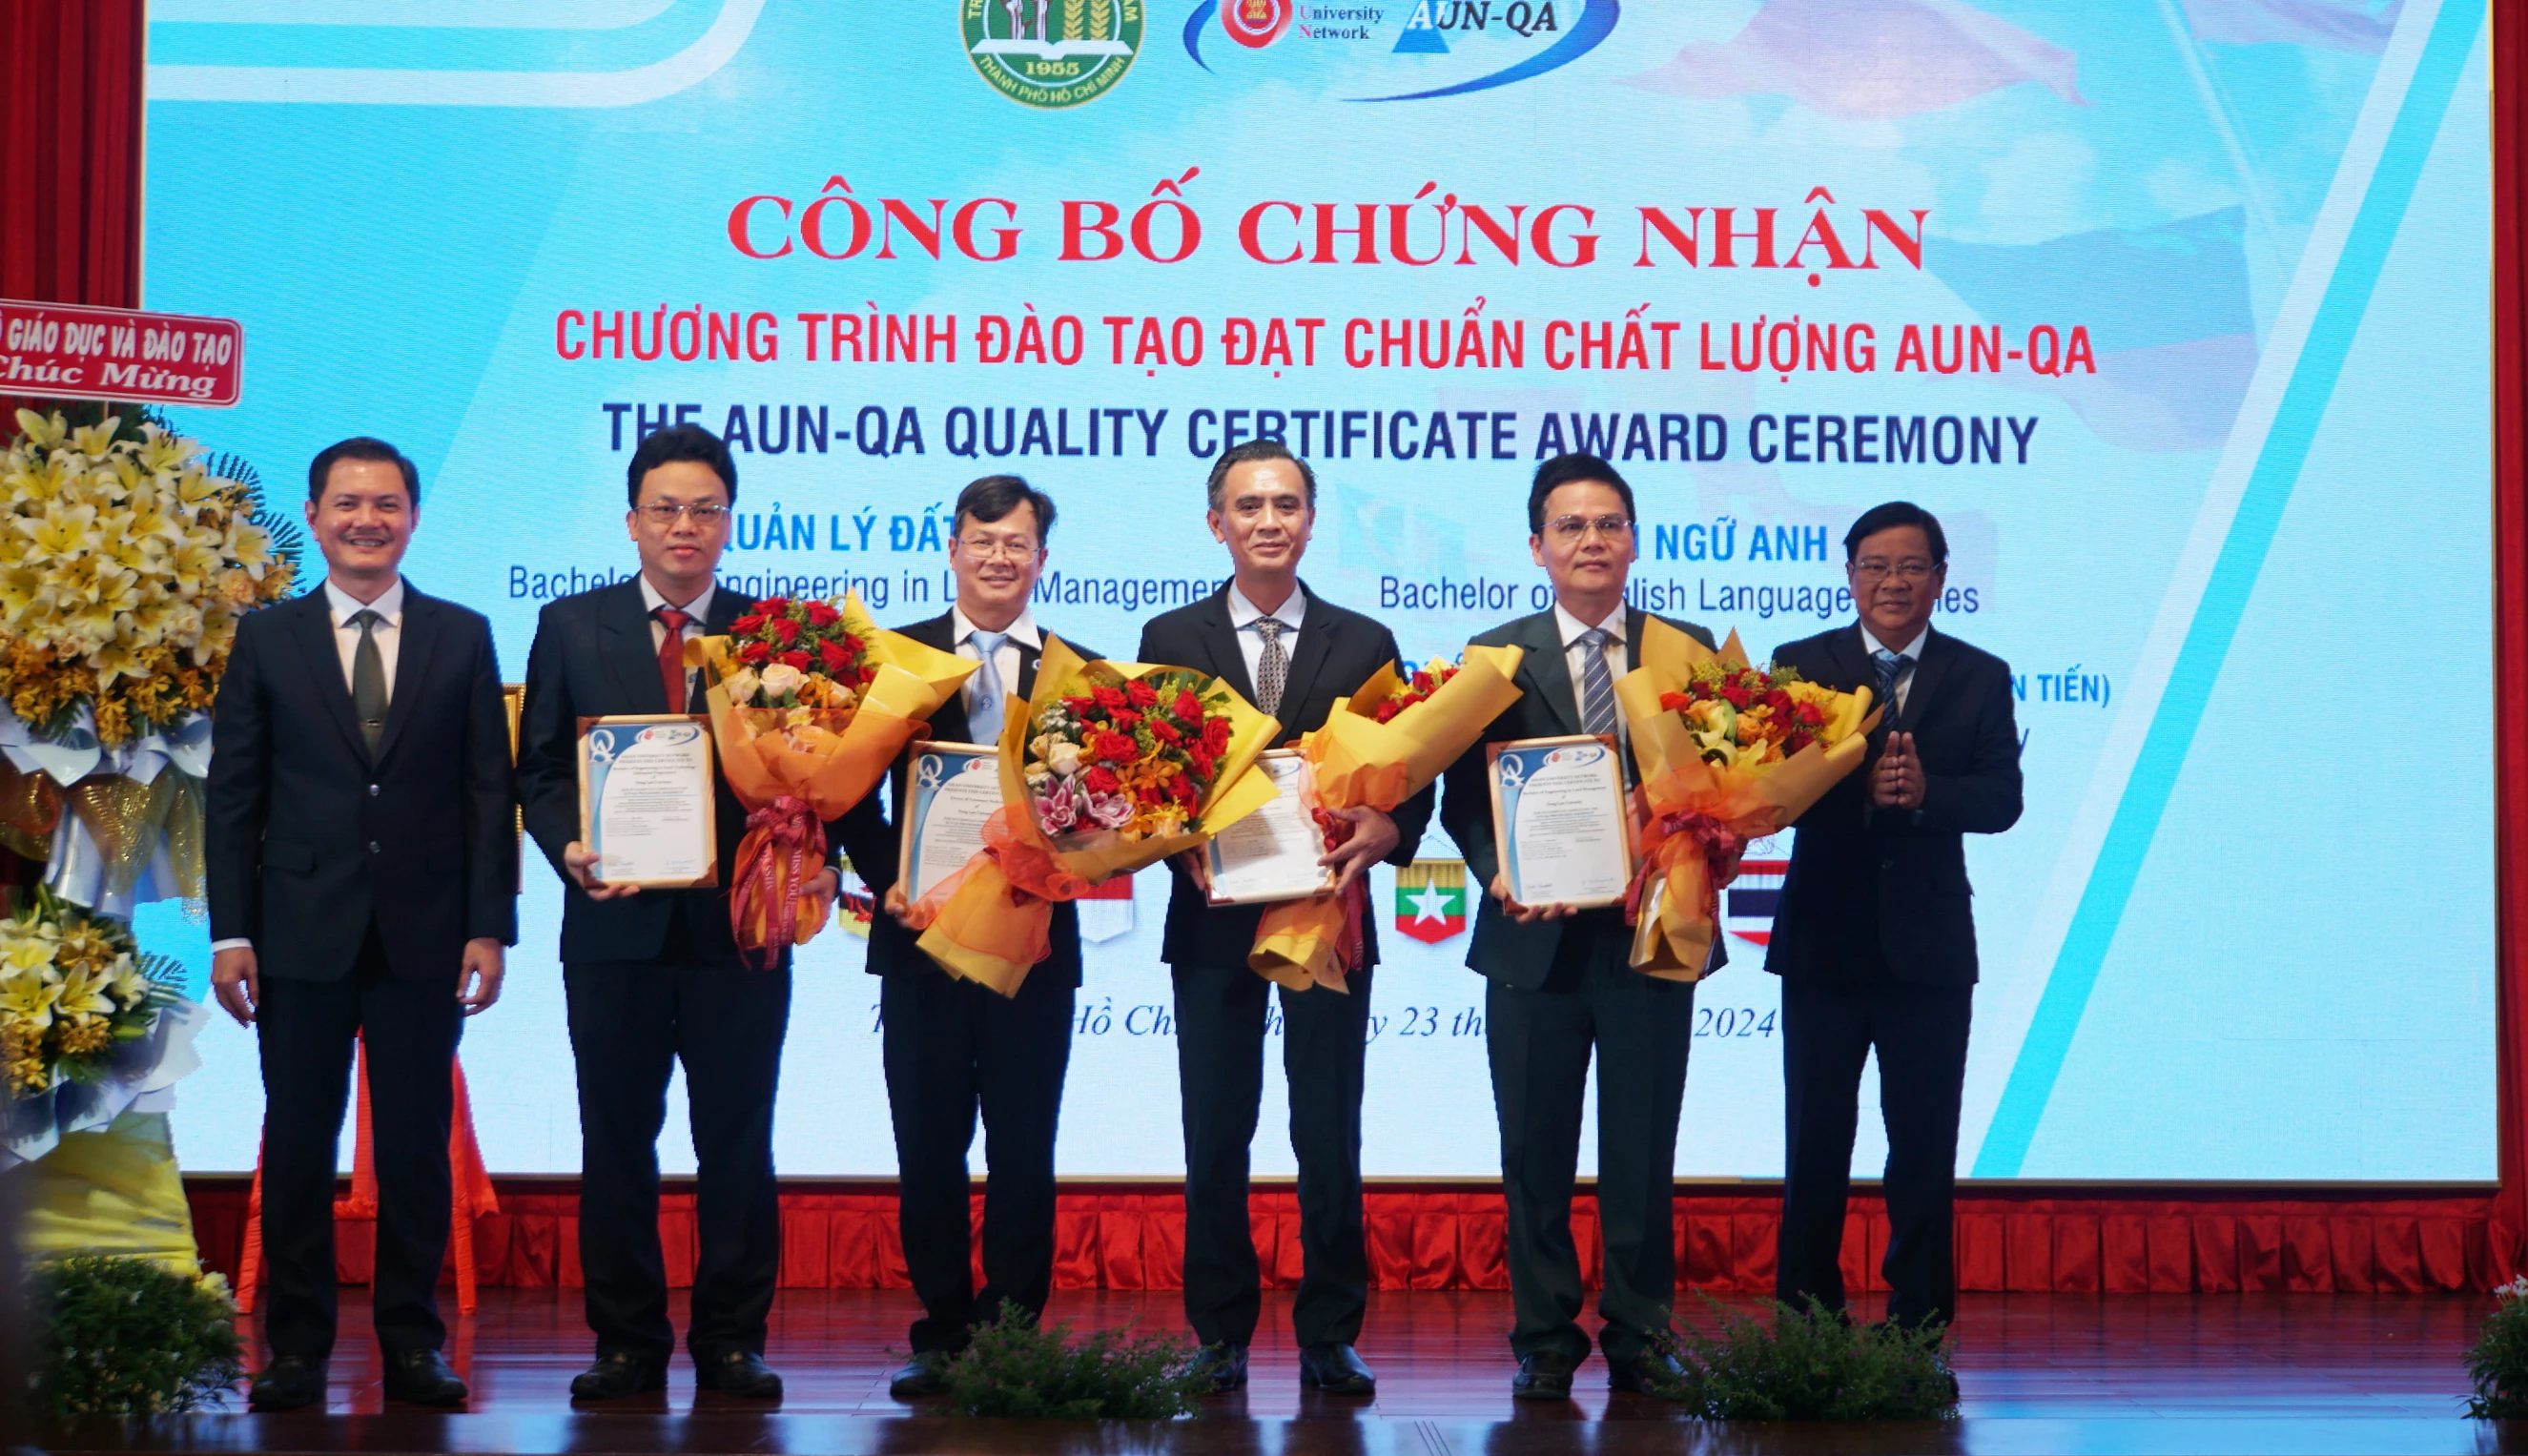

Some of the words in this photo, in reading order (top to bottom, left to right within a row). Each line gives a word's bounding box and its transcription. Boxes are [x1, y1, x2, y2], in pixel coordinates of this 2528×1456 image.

[1299, 24, 1370, 40] Network
[1300, 4, 1384, 25] University
[1407, 0, 1558, 37] AUN-QA
[979, 53, 1017, 93] THÀNH
[1096, 55, 1126, 88] MINH
[1025, 61, 1080, 76] 1955
[727, 175, 1023, 262] CÔNG
[1058, 166, 1202, 264] BỐ
[1238, 180, 1601, 268] CHỨNG
[1633, 186, 1933, 288] NHẬN
[8, 311, 60, 354] GIÁO
[63, 320, 107, 363] DỤC
[111, 318, 136, 359] VÀ
[143, 320, 187, 362] ĐÀO
[192, 332, 233, 372] TẠO
[556, 302, 779, 362] CHƯƠNG
[797, 300, 956, 363] TRÌNH
[975, 302, 1084, 366] ĐÀO
[1103, 317, 1203, 377] TẠO
[1221, 318, 1326, 379] ĐẠT
[1344, 296, 1525, 370] CHUẨN
[1544, 302, 1681, 371] CHẤT
[1699, 315, 1876, 382] LƯỢNG
[1895, 323, 2098, 378] AUN-QA
[99, 361, 217, 400] Mừng
[722, 404, 925, 459] AUN-QA
[945, 407, 1168, 459] QUALITY
[1188, 408, 1517, 460] CERTIFICATE
[1535, 412, 1728, 461] AWARD
[1748, 416, 2040, 464] CEREMONY
[723, 502, 815, 553] UẢN
[831, 505, 877, 551] LÝ
[1655, 515, 1737, 562] NGỮ
[1749, 525, 1828, 562] ANH
[715, 568, 889, 609] ngineering
[903, 569, 928, 603] in
[1381, 575, 1519, 610] Bachelor
[1700, 578, 1856, 620] Language
[2037, 664, 2110, 708] TIẾN)
[791, 848, 803, 873] MISS
[788, 874, 802, 902] YOU
[1399, 1006, 1439, 1037] 23
[1694, 1007, 1778, 1039] 2024
